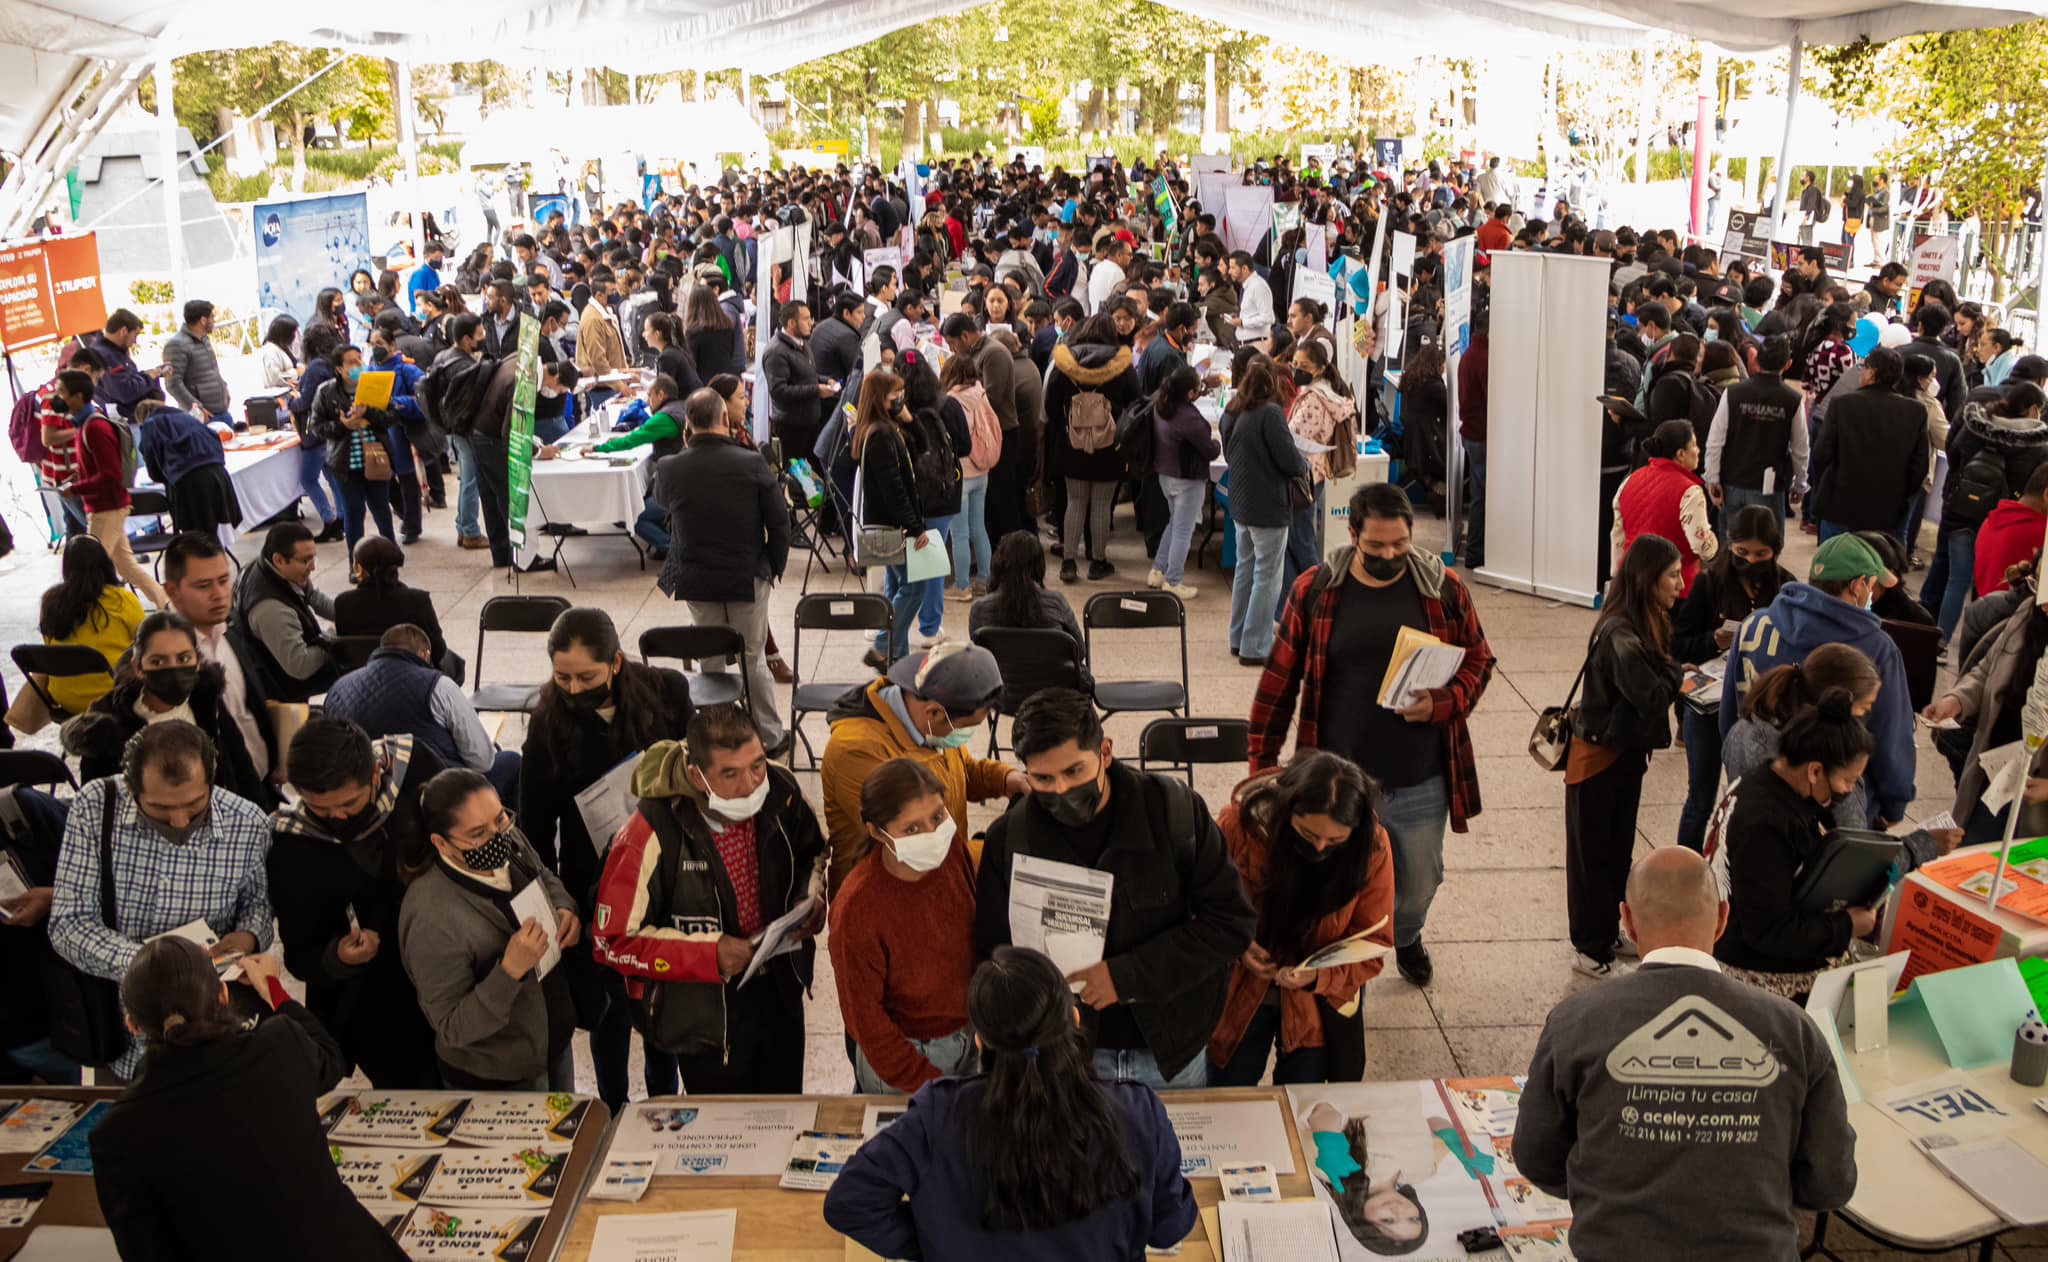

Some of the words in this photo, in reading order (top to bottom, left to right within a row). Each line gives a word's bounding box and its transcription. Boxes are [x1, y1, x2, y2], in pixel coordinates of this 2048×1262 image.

[1621, 1055, 1766, 1071] ACELEY
[1691, 1087, 1707, 1103] tu
[1712, 1089, 1758, 1104] casa!
[358, 1116, 376, 1124] DE
[377, 1117, 414, 1125] BONO
[1643, 1110, 1761, 1128] aceley.com.mx
[1617, 1123, 1636, 1137] 722
[1638, 1126, 1656, 1141] 216
[1659, 1128, 1682, 1142] 1661
[1695, 1129, 1713, 1142] 722
[1716, 1130, 1734, 1142] 199
[1736, 1131, 1759, 1143] 2422
[443, 1167, 527, 1176] SEMANALES
[457, 1176, 503, 1185] PAGOS
[417, 1240, 435, 1248] DE
[439, 1240, 483, 1249] BONO
